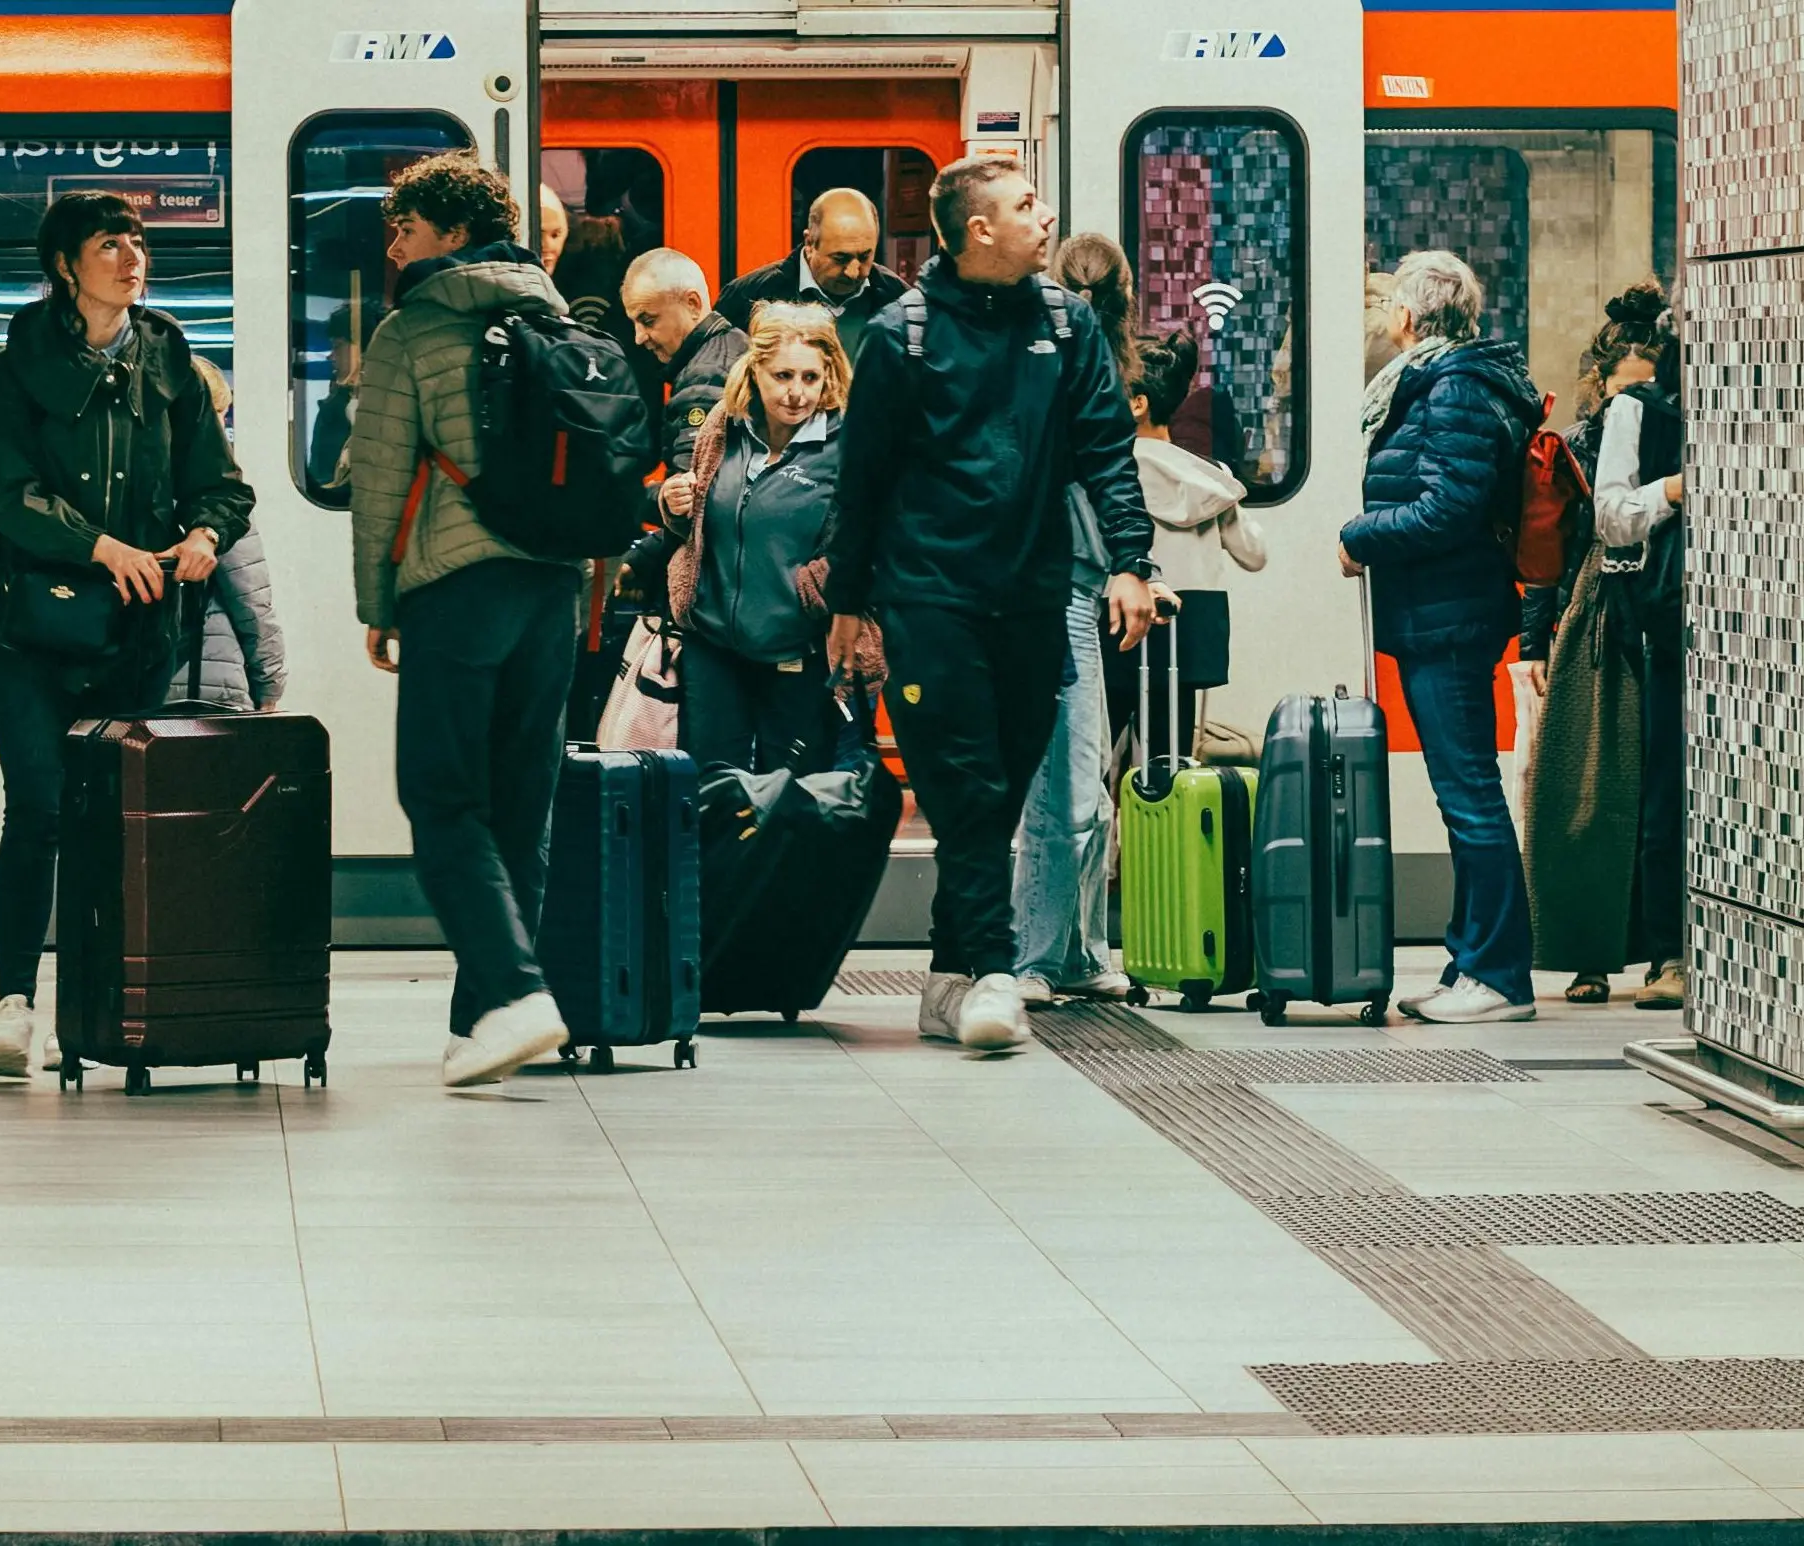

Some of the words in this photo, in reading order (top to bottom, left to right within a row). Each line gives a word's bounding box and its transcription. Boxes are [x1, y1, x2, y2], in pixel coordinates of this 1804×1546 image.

[354, 31, 444, 61] RMV
[1184, 30, 1275, 60] RMV
[160, 193, 203, 207] teuer
